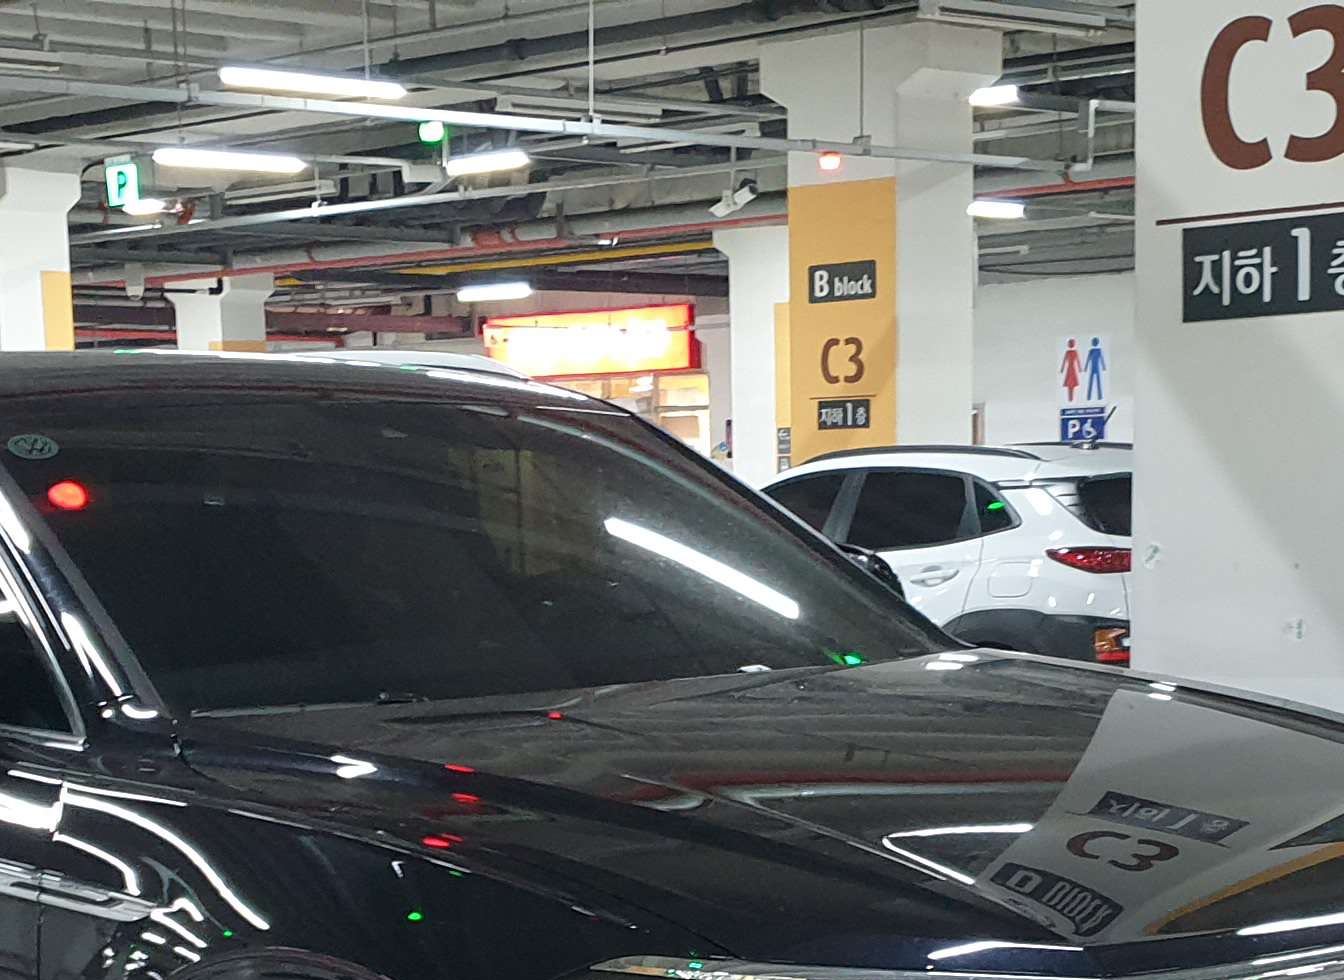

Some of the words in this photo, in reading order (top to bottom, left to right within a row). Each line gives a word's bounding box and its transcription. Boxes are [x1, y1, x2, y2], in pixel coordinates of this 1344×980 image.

[813, 270, 829, 298] B
[834, 274, 873, 297] block
[1193, 246, 1278, 306] 지하
[821, 337, 865, 385] C3
[819, 405, 843, 426] 지하
